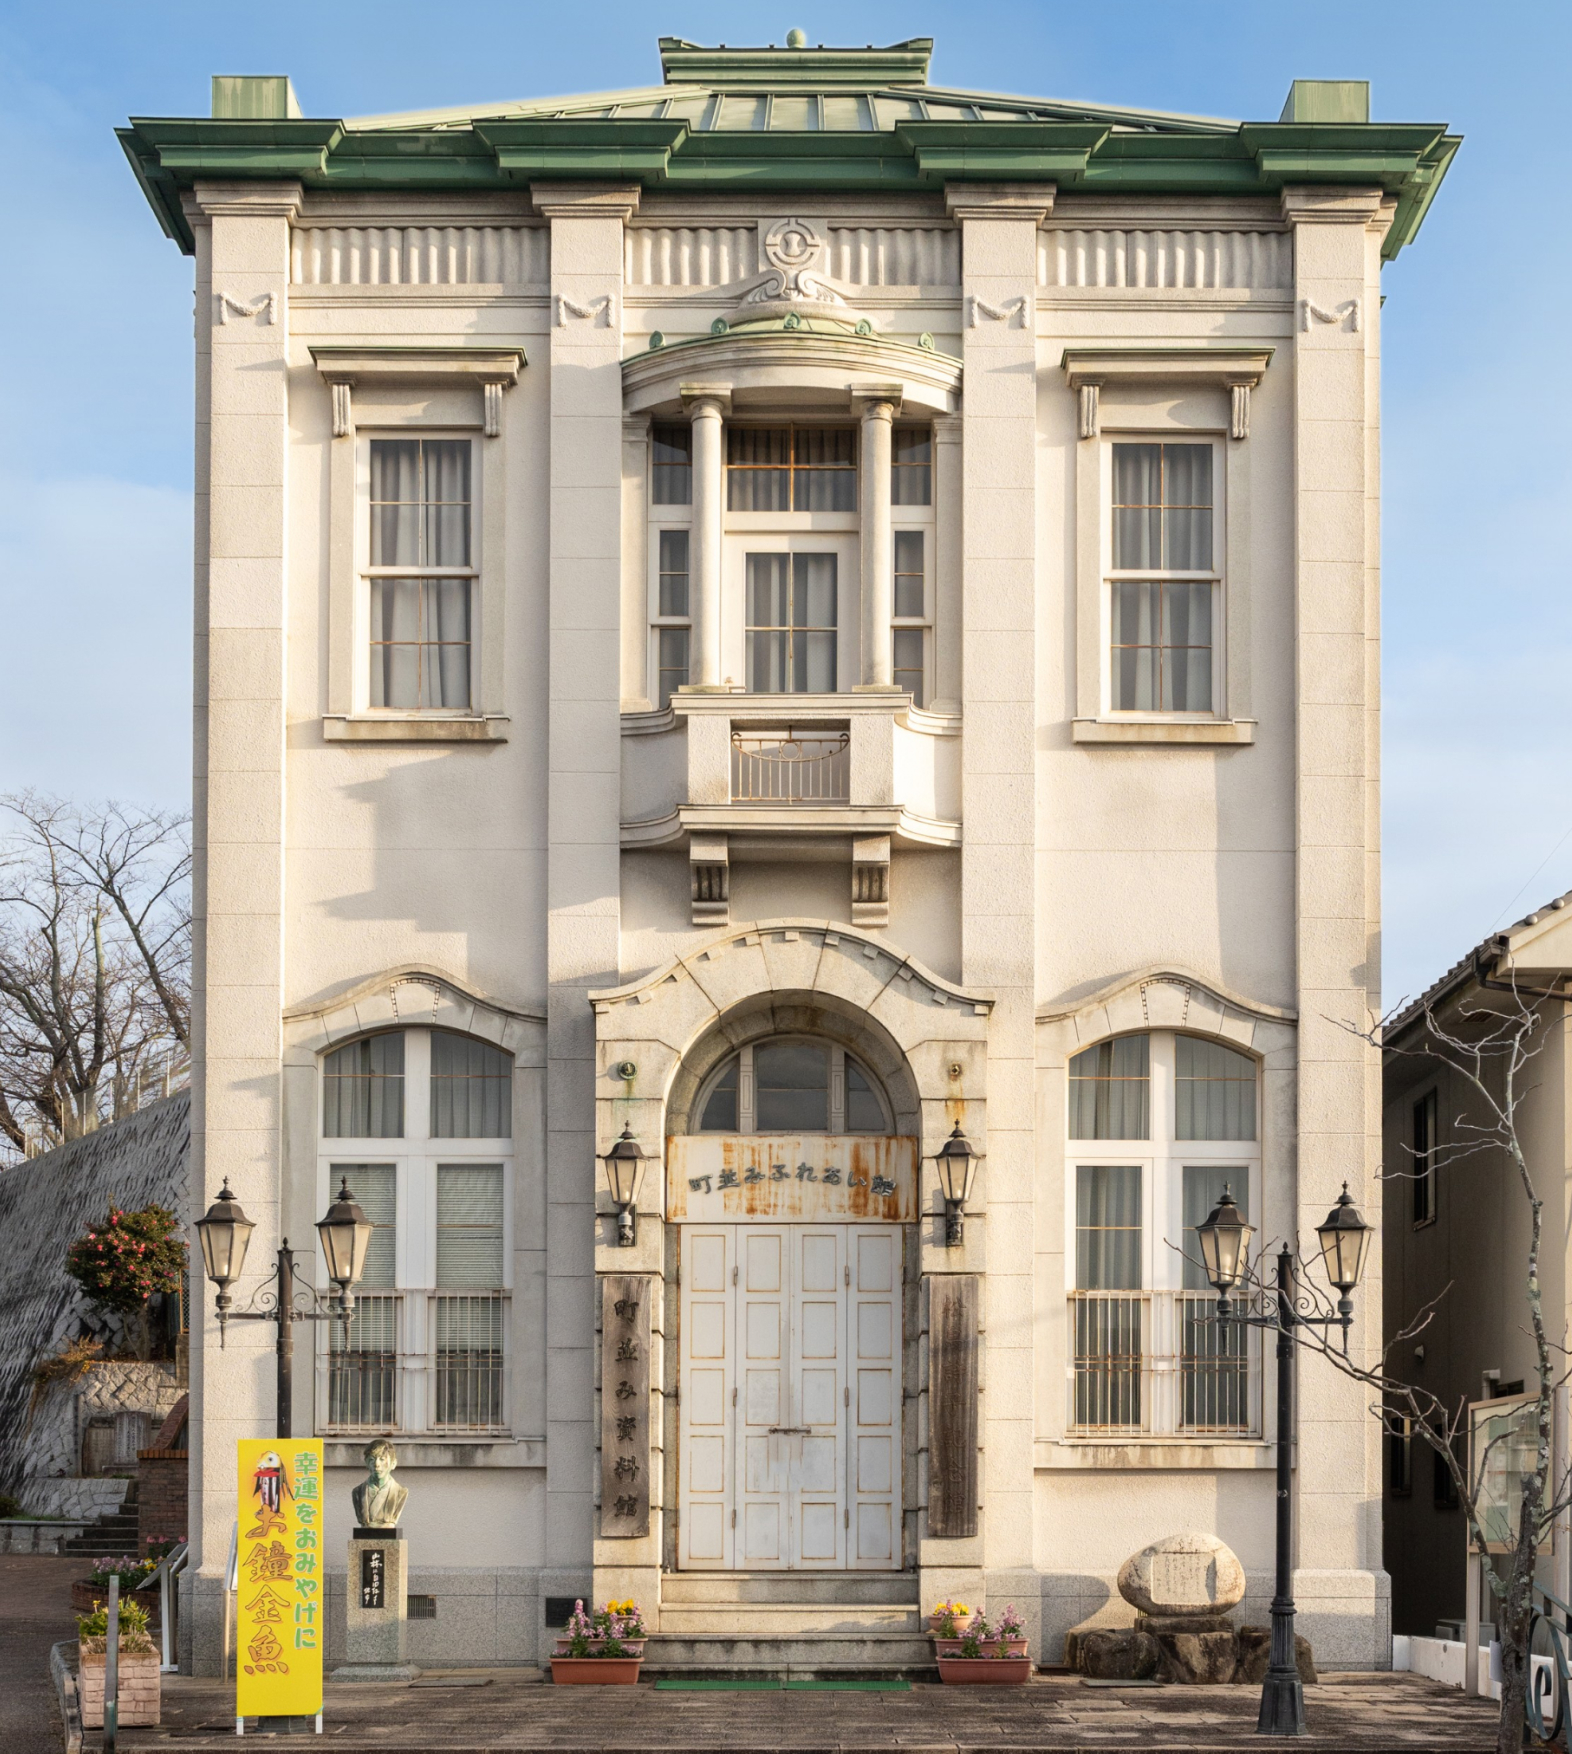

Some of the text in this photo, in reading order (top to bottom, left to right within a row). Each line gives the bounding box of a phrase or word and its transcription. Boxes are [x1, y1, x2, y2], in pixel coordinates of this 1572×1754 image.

[688, 1162, 897, 1197] 町並みふれあい館
[614, 1299, 640, 1517] 町並み資料館
[242, 1504, 293, 1675] お鐘金魚
[294, 1452, 319, 1650] 幸運をおみやげに
